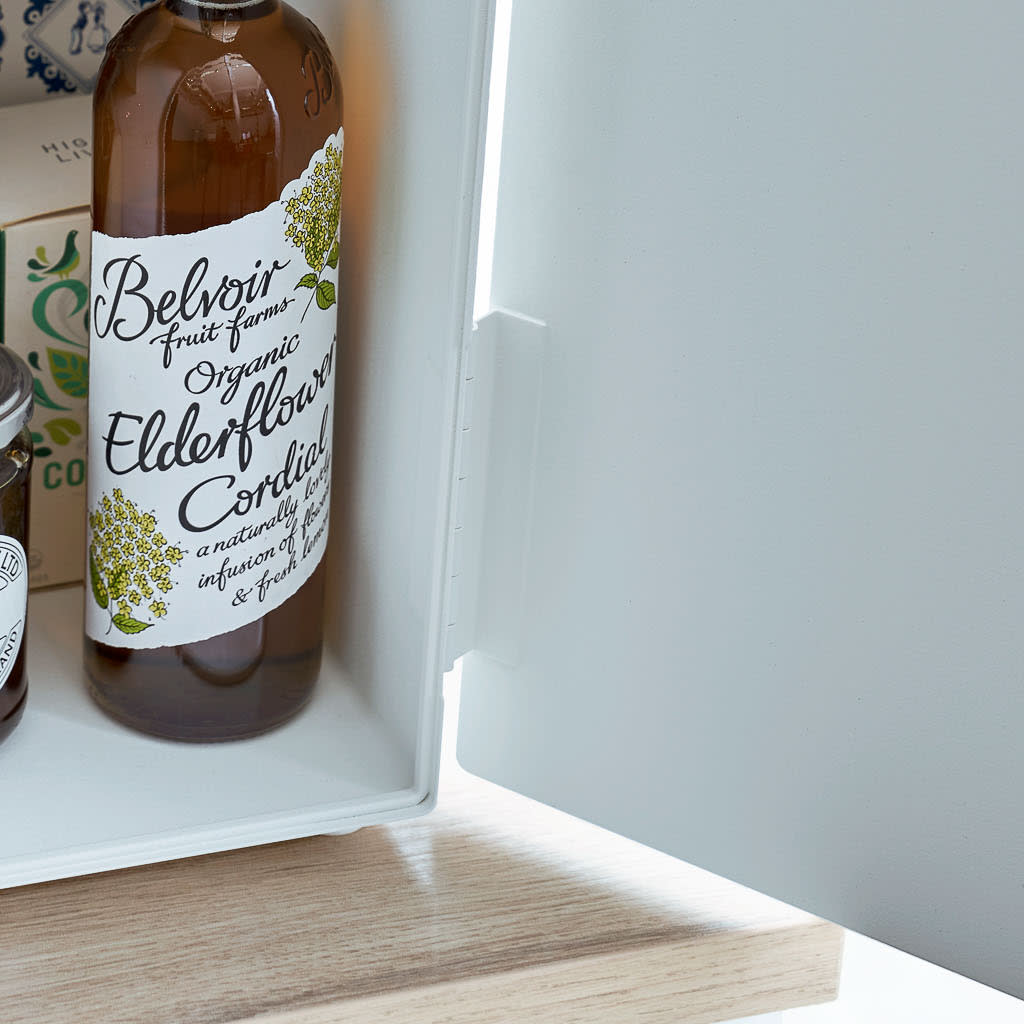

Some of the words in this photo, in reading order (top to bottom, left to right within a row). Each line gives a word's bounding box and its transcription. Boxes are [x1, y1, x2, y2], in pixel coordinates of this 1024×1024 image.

[94, 254, 291, 341] Belvoir
[149, 322, 223, 369] fruit
[226, 297, 295, 353] farms
[184, 333, 300, 404] Organic
[102, 334, 336, 475] Elderflower
[43, 459, 85, 490] CO
[178, 403, 329, 532] Cordial
[196, 545, 210, 557] a
[213, 495, 299, 553] naturally
[198, 557, 276, 591] infusion
[278, 517, 298, 554] of
[0, 551, 20, 577] LTD
[231, 588, 253, 606] &
[255, 550, 297, 602] fresh
